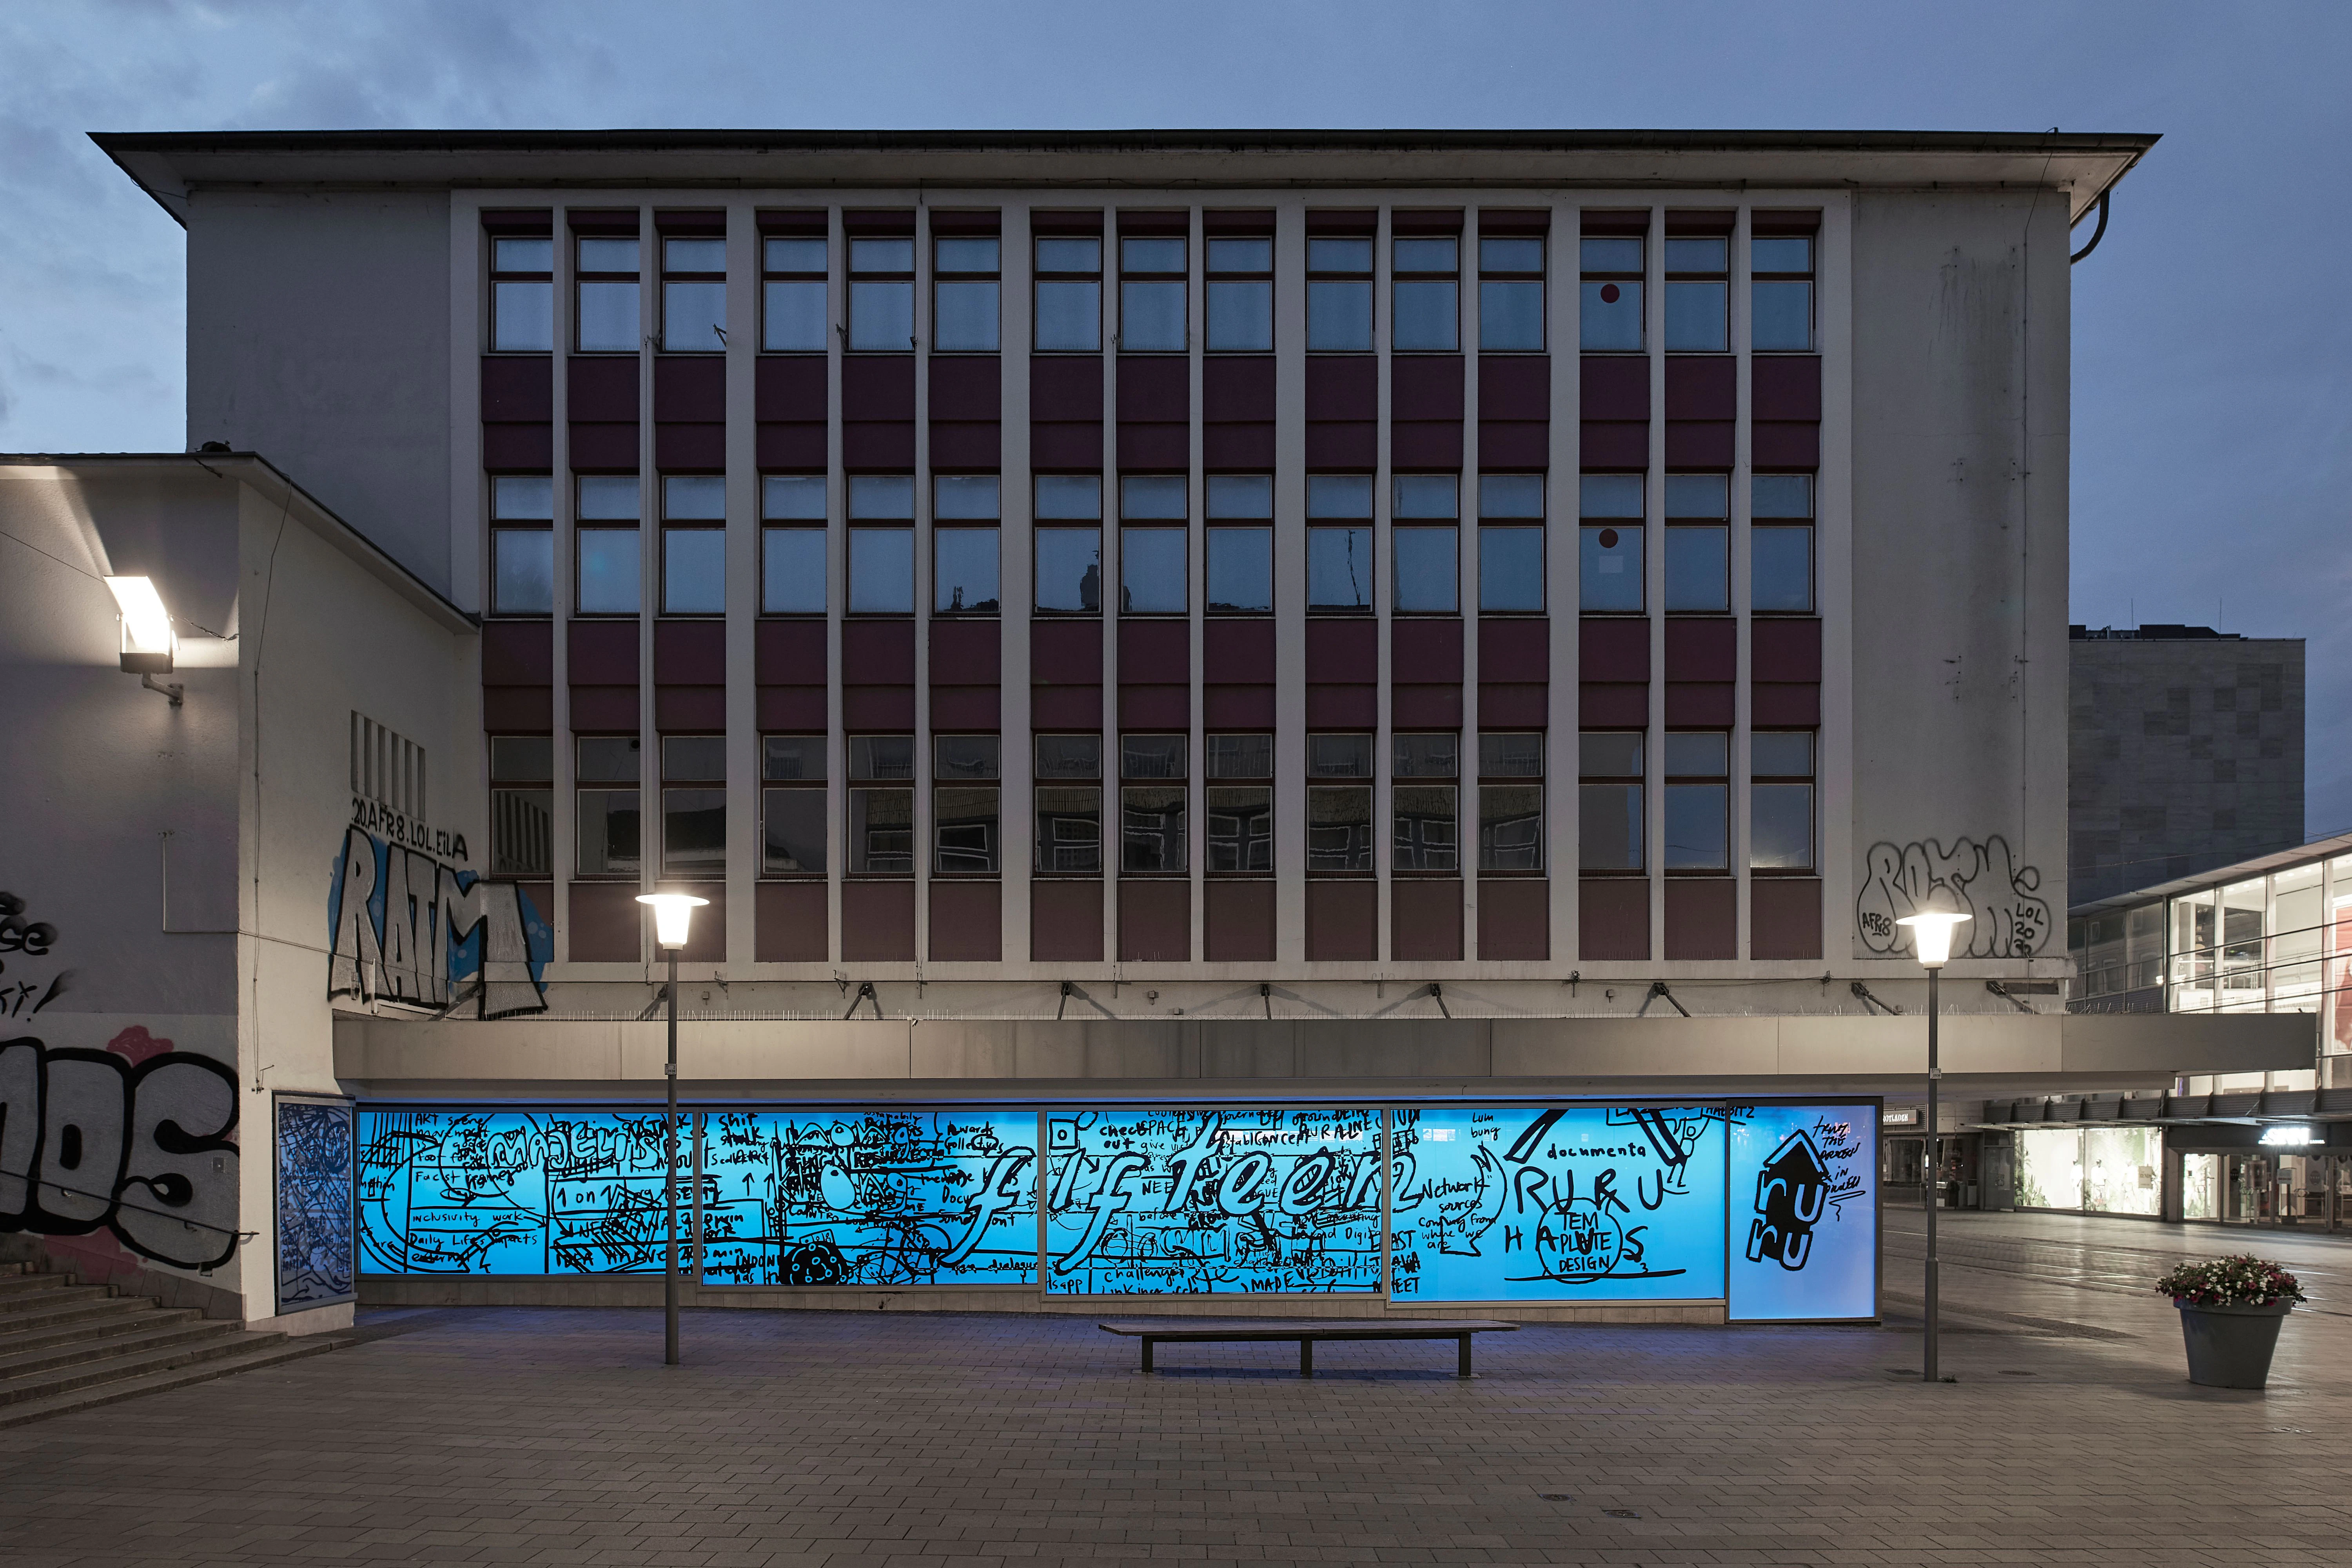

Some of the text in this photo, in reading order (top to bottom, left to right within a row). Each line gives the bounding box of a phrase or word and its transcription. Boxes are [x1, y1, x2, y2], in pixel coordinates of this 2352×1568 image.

[2016, 902, 2043, 925] LOL
[1471, 1127, 1501, 1141] bung
[1547, 1142, 1647, 1159] documenta
[576, 1190, 596, 1204] on
[413, 1212, 481, 1227] inclusivity
[409, 1233, 445, 1252] Daily
[1559, 1254, 1610, 1273] DESIGN
